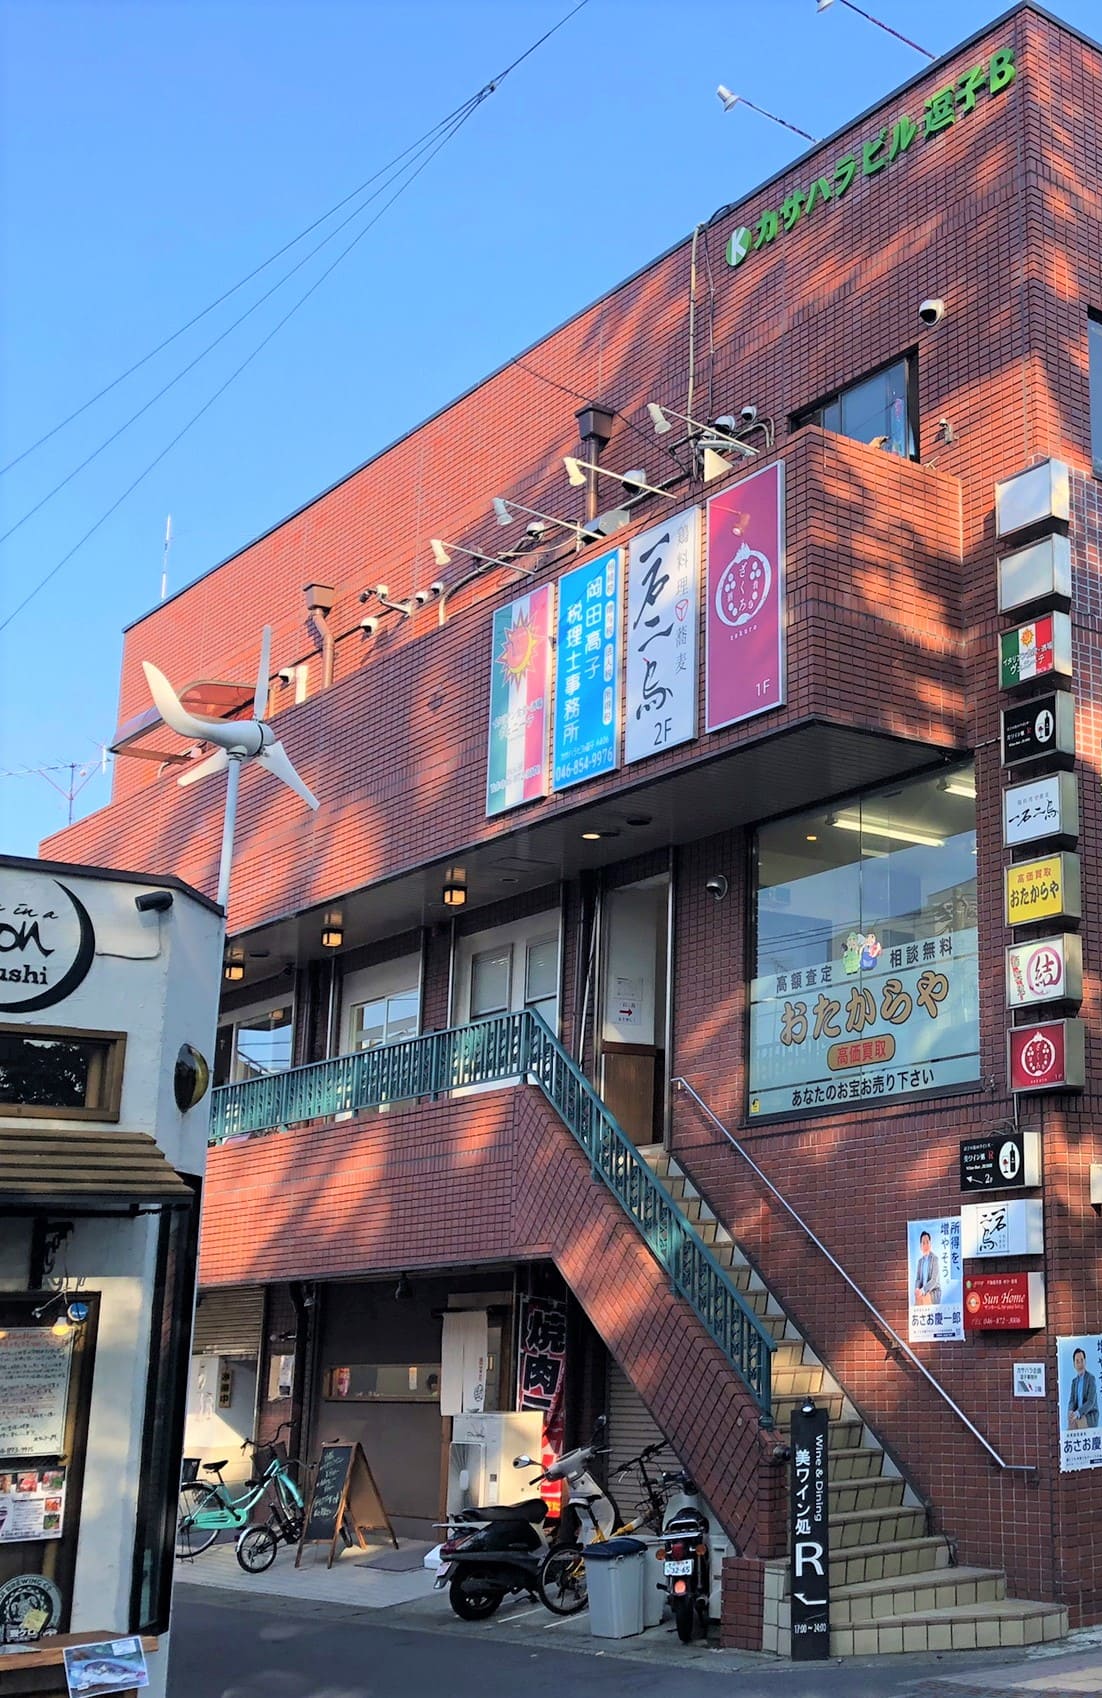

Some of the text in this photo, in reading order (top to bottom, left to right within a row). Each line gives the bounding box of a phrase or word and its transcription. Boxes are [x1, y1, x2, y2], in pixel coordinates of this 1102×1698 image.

[563, 600, 583, 746] 税理士事務所
[755, 678, 771, 697] 1F
[653, 717, 673, 746] 2F
[1017, 866, 1052, 883] 高価買取
[1010, 880, 1060, 908] おたからや
[776, 936, 953, 994] 高額査定 相談無料
[779, 969, 950, 1047] おたからや
[836, 1039, 887, 1066] 高価買取
[792, 1068, 935, 1107] あなたのお宝お売り下さい
[951, 1221, 960, 1271] 所得を、
[983, 1288, 1026, 1305] Sun Home
[912, 1311, 961, 1327] あさお慶一郎
[815, 1434, 824, 1466] Wine
[795, 1448, 812, 1536] 美ワイン処
[814, 1480, 824, 1521] Dining
[795, 1542, 825, 1577] R
